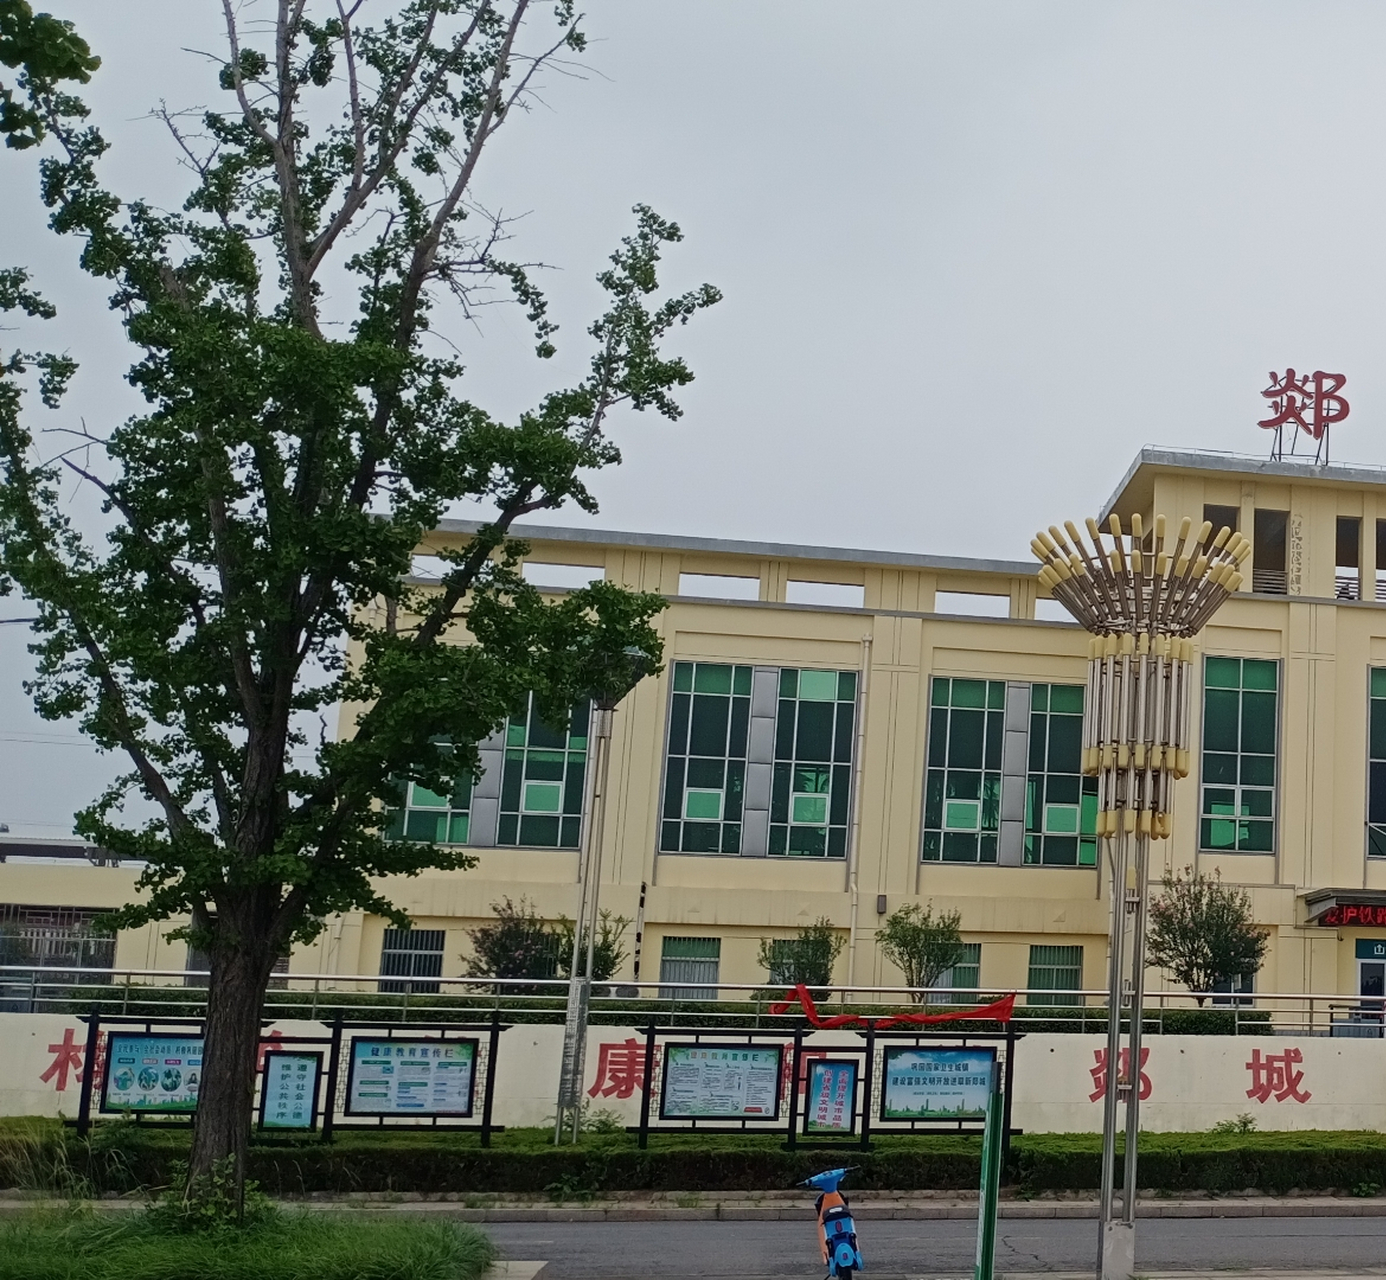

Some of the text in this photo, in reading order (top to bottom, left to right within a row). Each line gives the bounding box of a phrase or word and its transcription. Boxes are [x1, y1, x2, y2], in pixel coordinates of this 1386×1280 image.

[370, 1046, 454, 1059] 健康教育宣传栏
[275, 1063, 292, 1119] 维护公共秩序
[292, 1063, 308, 1120] 遵守社会公德
